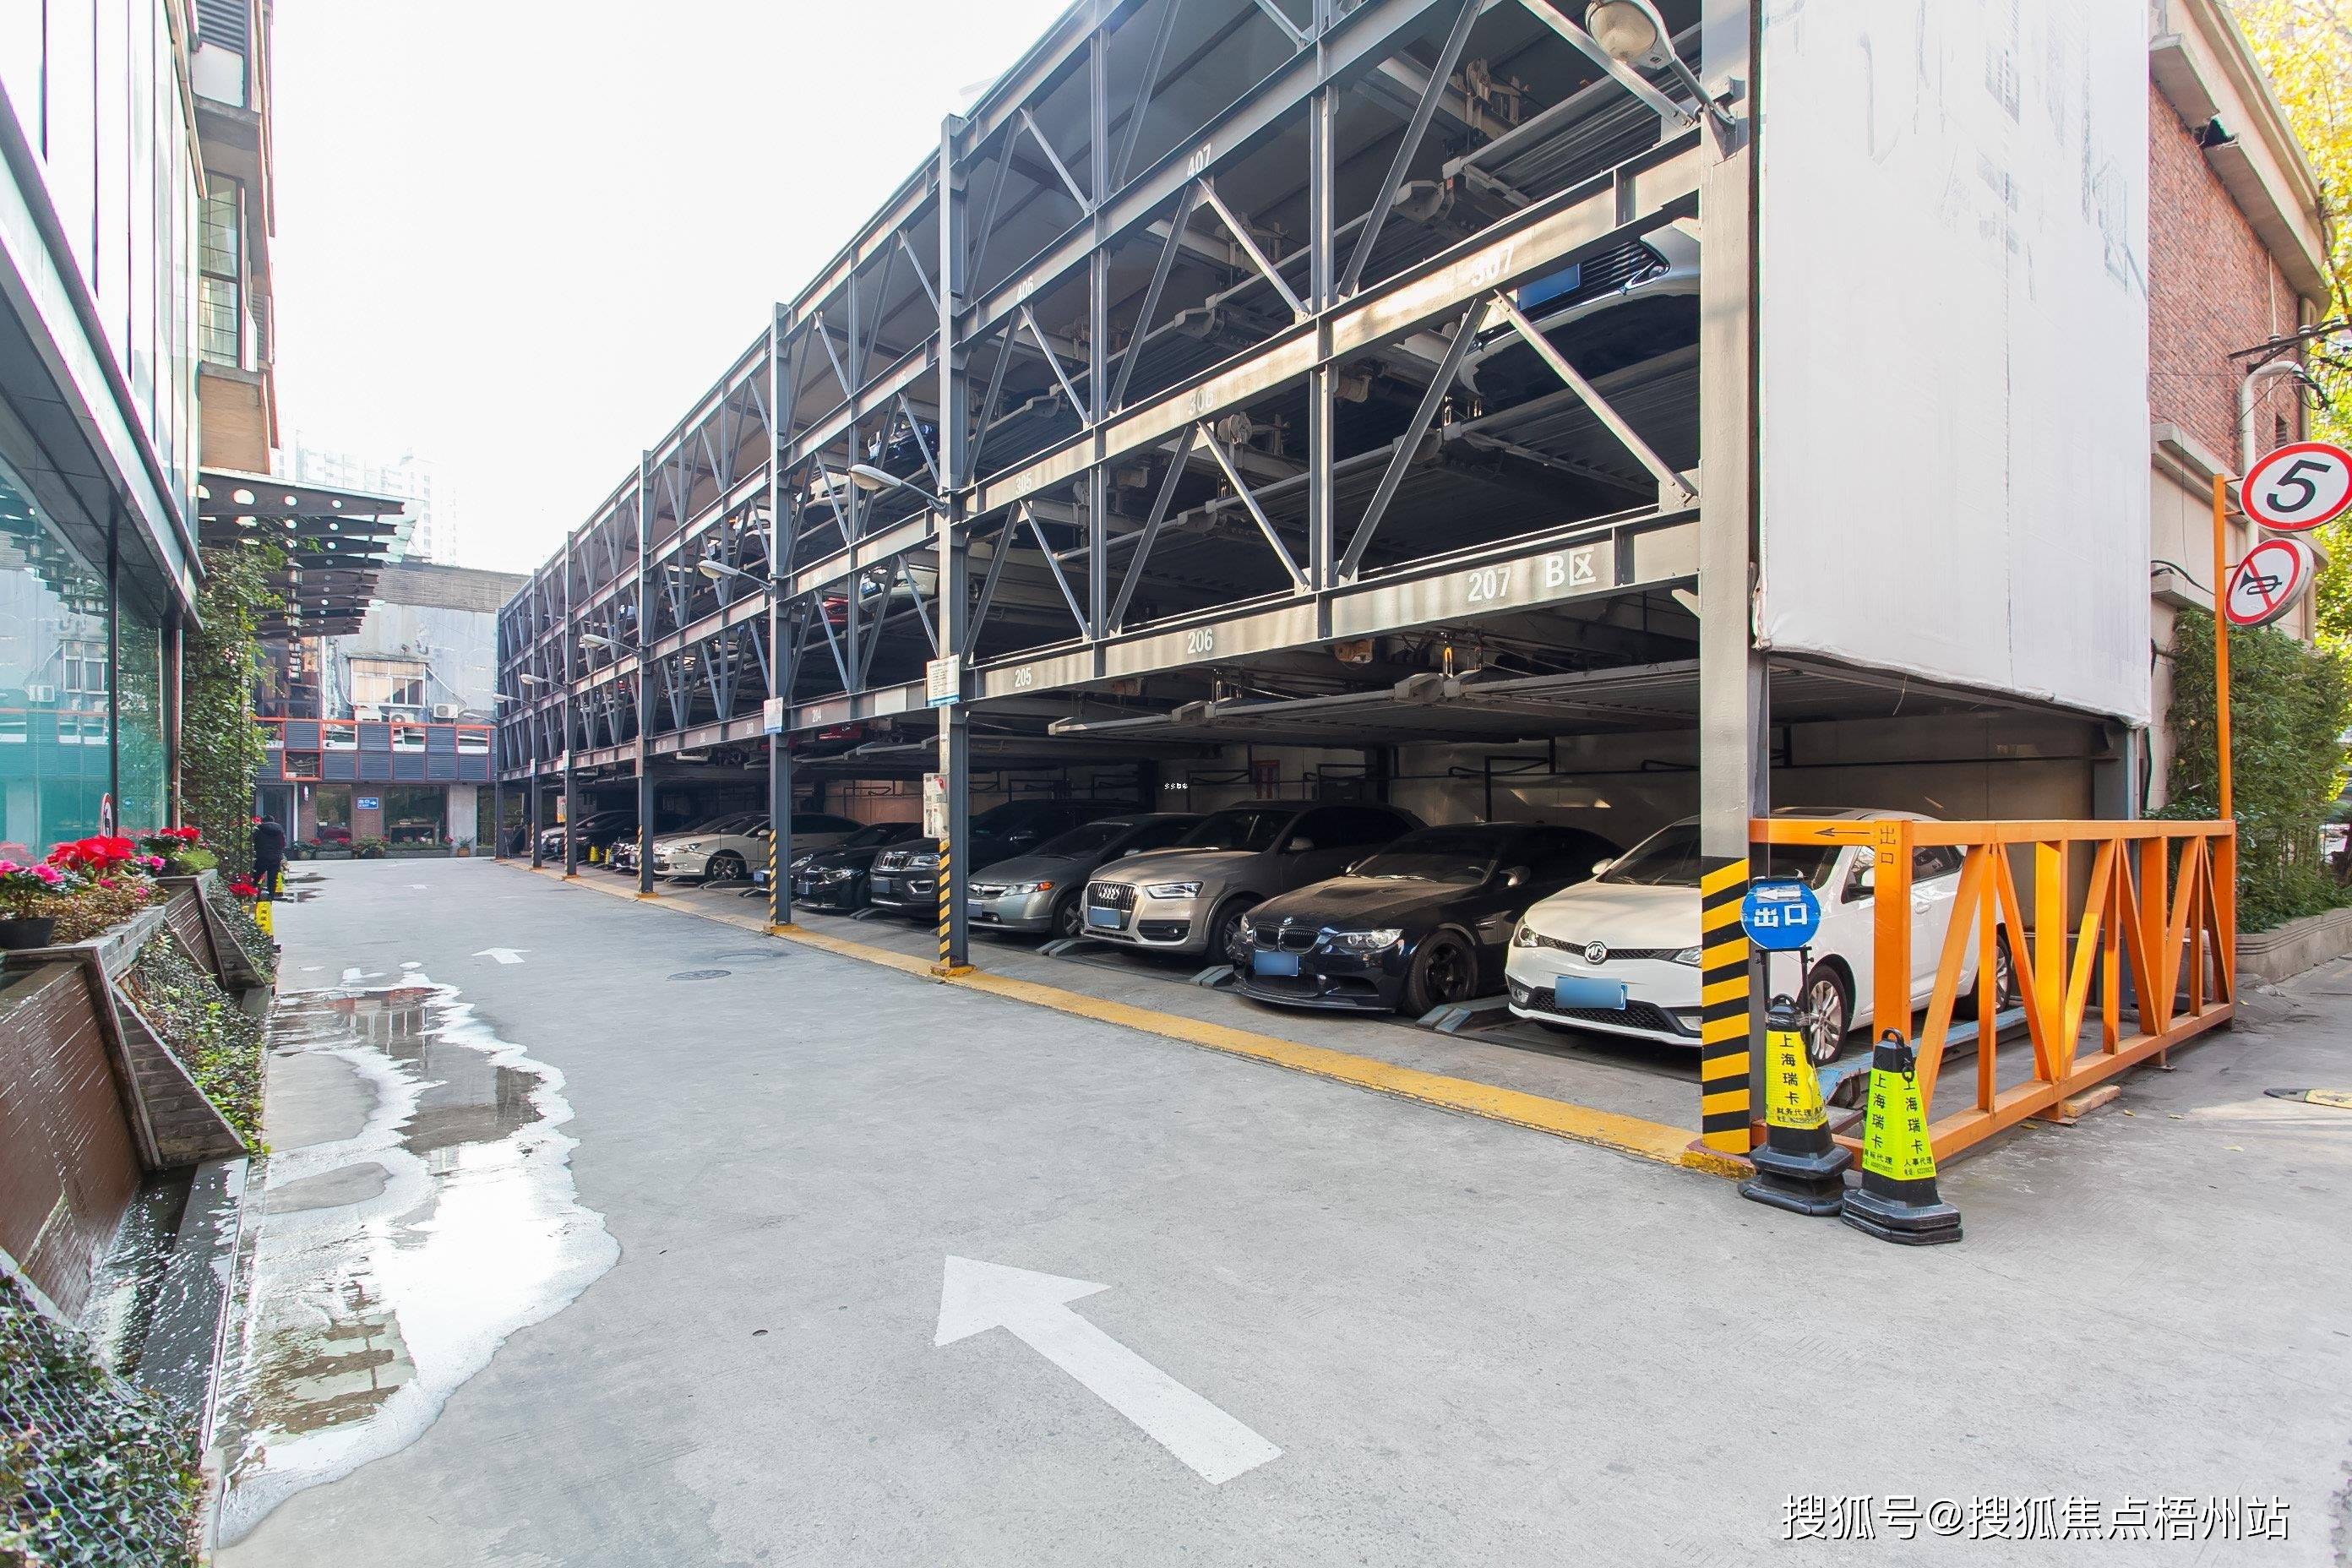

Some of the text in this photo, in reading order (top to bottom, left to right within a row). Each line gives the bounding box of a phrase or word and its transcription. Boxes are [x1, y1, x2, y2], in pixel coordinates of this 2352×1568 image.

[1187, 143, 1211, 177] 407
[1015, 473, 1032, 494] 305
[2267, 460, 2331, 513] 5
[1467, 547, 1597, 602] 207 B区
[1187, 628, 1213, 654] 206
[1015, 667, 1032, 688] 205
[1880, 825, 1896, 863] 出口
[1754, 903, 1808, 927] 出口
[1779, 1034, 1799, 1105] 上海瑞卡
[1870, 1073, 1886, 1149] 上海瑞卡
